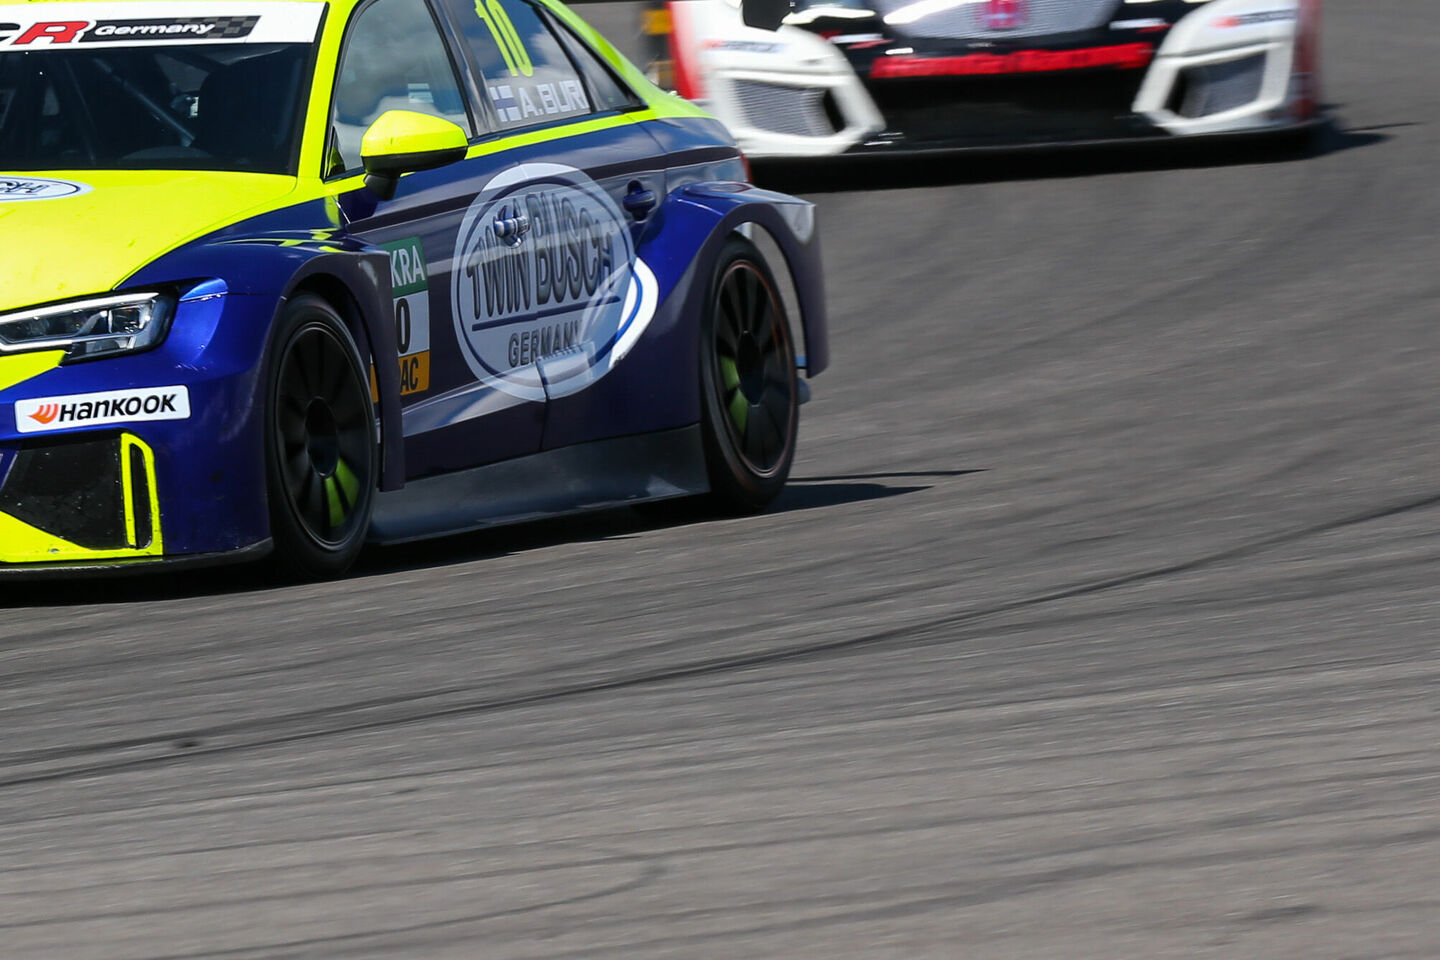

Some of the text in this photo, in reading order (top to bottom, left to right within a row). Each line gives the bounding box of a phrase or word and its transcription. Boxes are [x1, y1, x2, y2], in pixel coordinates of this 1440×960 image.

[93, 20, 216, 38] Germany
[390, 245, 426, 288] KRA
[525, 192, 616, 306] BUSCH
